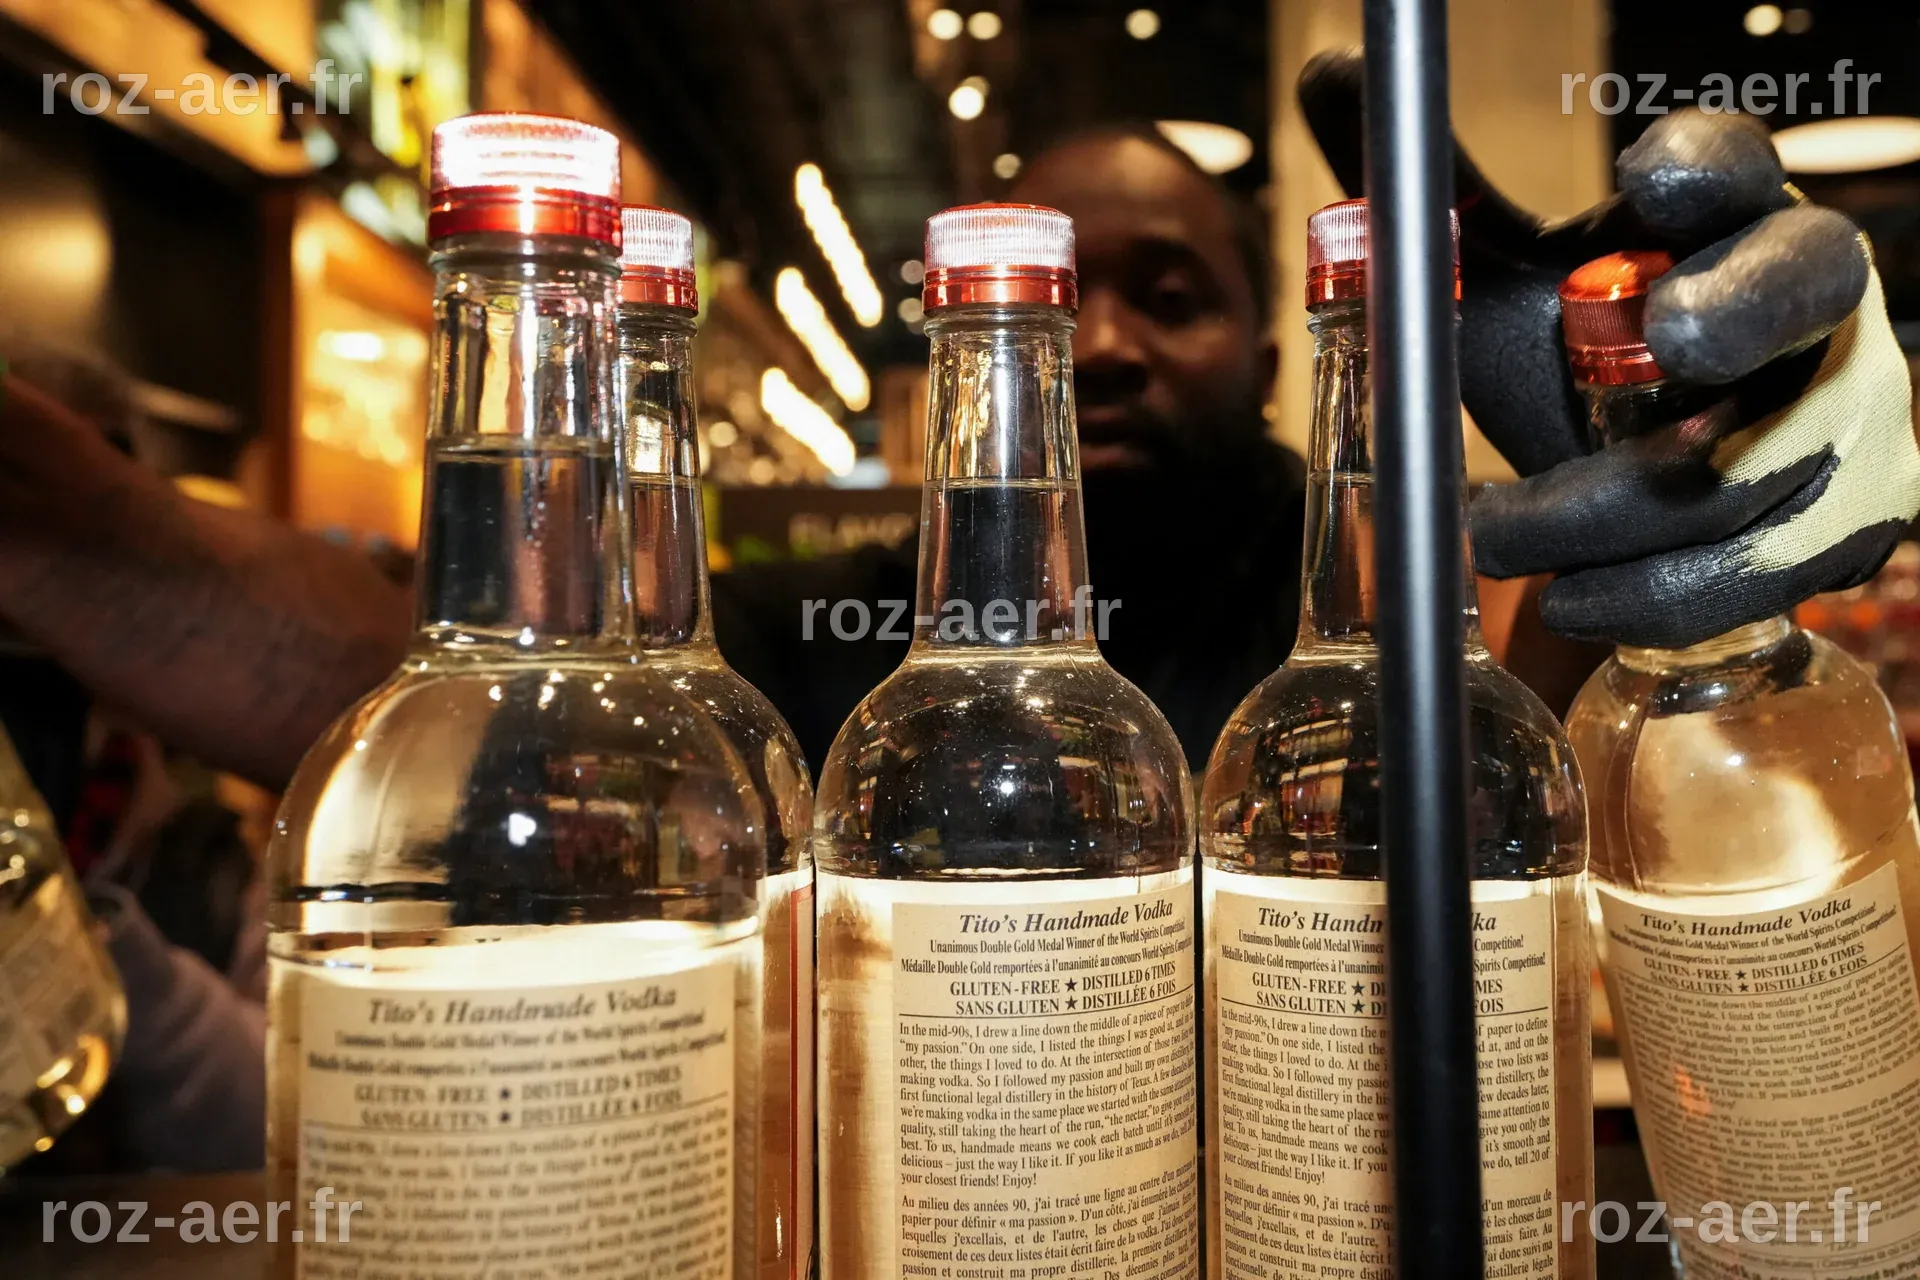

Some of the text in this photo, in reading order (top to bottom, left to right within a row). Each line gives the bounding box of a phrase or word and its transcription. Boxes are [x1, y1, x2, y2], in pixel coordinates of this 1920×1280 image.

[960, 899, 1173, 933] Tito's Handmade Vodka
[1259, 908, 1305, 929] Tito's
[1640, 914, 1685, 933] Tito's
[1691, 915, 1793, 937] Handmade
[1798, 898, 1851, 925] Vodka
[930, 940, 978, 953] Unanimous
[980, 940, 1012, 953] Double
[1014, 939, 1035, 952] Gold
[1038, 938, 1064, 952] Medal
[1066, 936, 1094, 949] Winner
[1097, 934, 1105, 946] of
[1108, 934, 1118, 945] the
[1120, 930, 1139, 944] World
[1140, 926, 1159, 942] Spirits
[1239, 929, 1384, 953] Unanimous Double Gold Medal Winner
[1474, 935, 1524, 954] Competition!
[1685, 939, 1703, 949] Gold
[1705, 940, 1729, 950] Medal
[1730, 941, 1758, 949] Winner
[1761, 938, 1769, 947] of
[1772, 936, 1784, 946] the
[1785, 929, 1808, 943] World
[1810, 923, 1835, 938] Spirits
[1814, 936, 1836, 951] World
[1838, 931, 1860, 943] Spirits
[901, 958, 935, 973] Médaille
[938, 960, 968, 974] Double
[970, 960, 991, 974] Gold
[994, 960, 1042, 977] remportées
[1045, 962, 1050, 972] à
[1053, 954, 1099, 971] l'unanimité
[1100, 957, 1110, 966] au
[1111, 952, 1141, 965] concours
[1142, 946, 1158, 960] World
[1160, 942, 1174, 959] Spirits
[1244, 950, 1265, 965] Double
[1267, 953, 1283, 968] Gold
[1285, 958, 1329, 974] remportées
[1331, 959, 1336, 972] à
[1339, 960, 1384, 974] l'unanimit
[1474, 952, 1545, 975] Spirits Competition!
[1752, 960, 1818, 979] DISTILLED
[1821, 957, 1828, 966] 6
[1828, 942, 1864, 963] TIMES
[1082, 969, 1143, 990] DISTILLED
[1145, 971, 1150, 981] 6
[1151, 961, 1176, 979] TIMES
[1475, 979, 1502, 994] MES
[1681, 980, 1733, 993] GLUTEN
[1830, 969, 1836, 978] 6
[1840, 955, 1867, 975] FOIS
[444, 994, 597, 1024] Handmade
[956, 979, 1176, 1015] SANS GLUTEN DISTILLÉE 6 FOIS
[1257, 991, 1346, 1014] SANS GLUTEN
[900, 1006, 1165, 1038] In the mid-90s, I drew a line down the middle of a piece of
[969, 1042, 984, 1054] On
[990, 1045, 1008, 1054] one
[1012, 1042, 1036, 1054] side,
[1041, 1041, 1044, 1052] I
[1050, 1038, 1076, 1051] listed
[1080, 1036, 1094, 1049] the
[1099, 1034, 1125, 1046] things
[1128, 1030, 1130, 1041] I
[1134, 1030, 1148, 1040] was
[1150, 1024, 1165, 1038] good
[900, 1041, 1151, 1073] other, the things I loved to do. At the intersection of
[901, 1172, 1036, 1188] your closest friends! Enjoy!
[1223, 1151, 1325, 1185] your closest friends! Enjoy!
[902, 1185, 1137, 1212] Au milieu des années 90, j'ai tracé une ligne au
